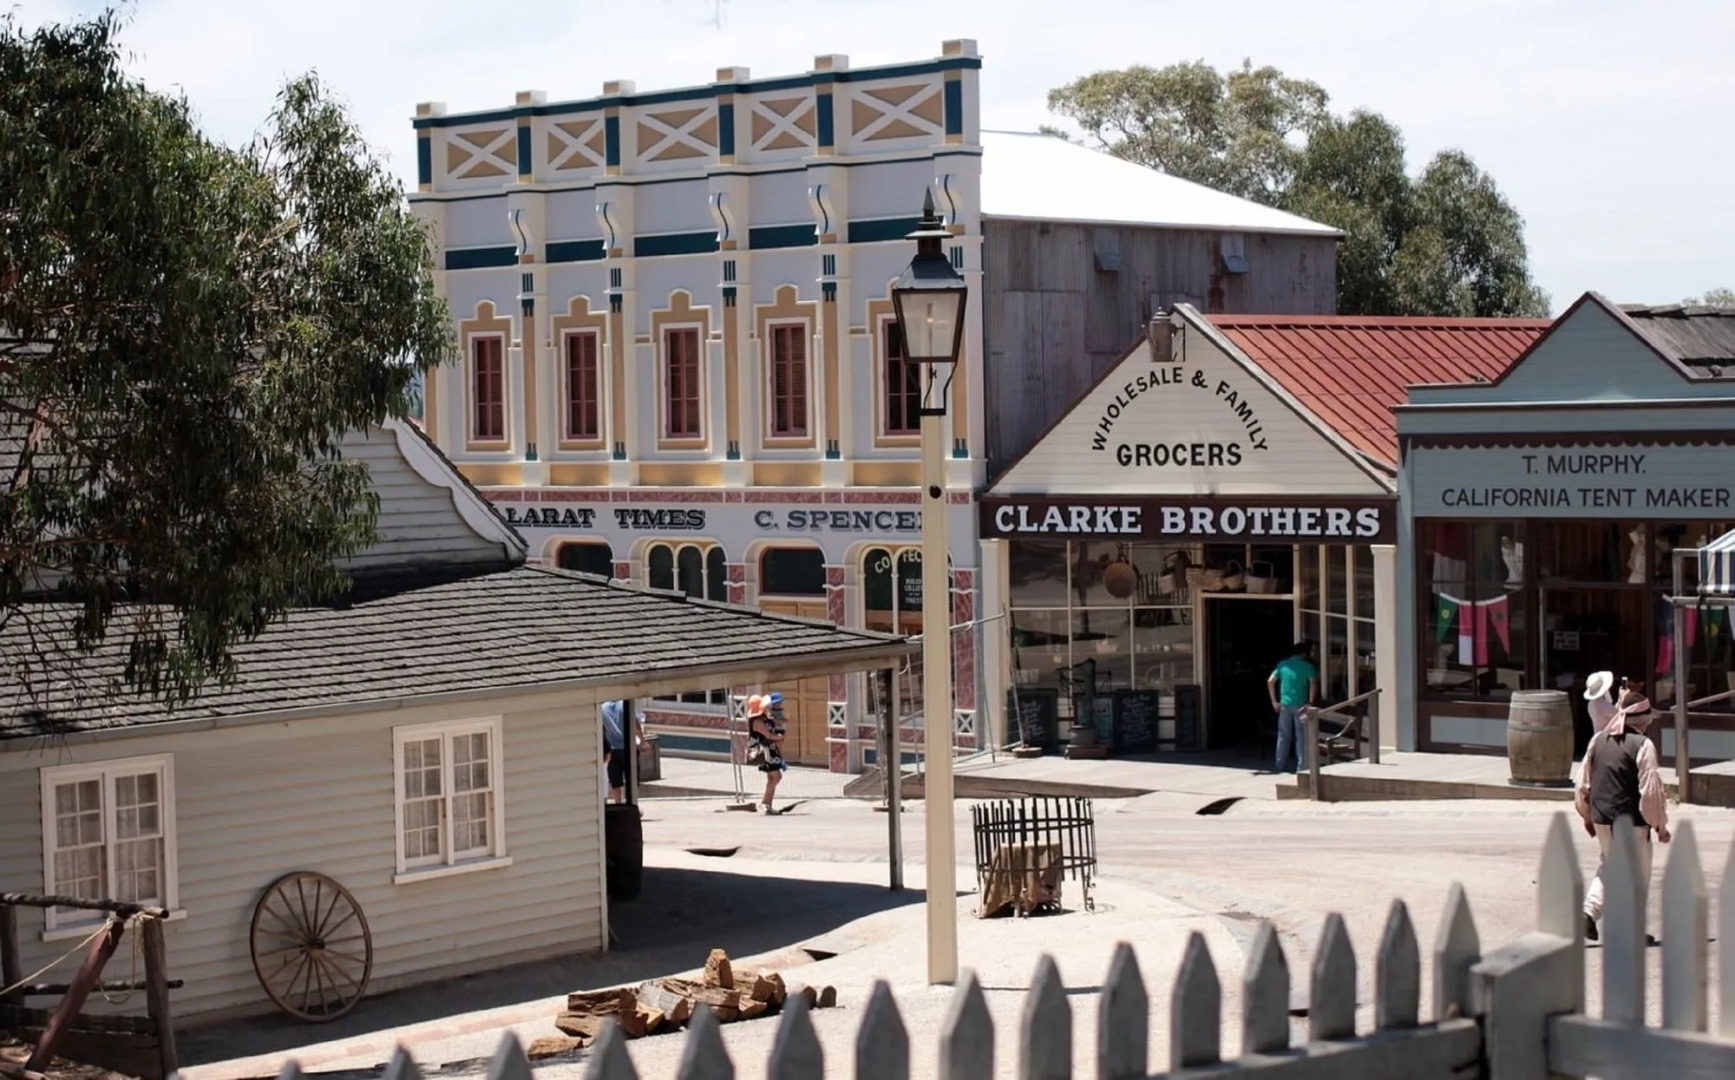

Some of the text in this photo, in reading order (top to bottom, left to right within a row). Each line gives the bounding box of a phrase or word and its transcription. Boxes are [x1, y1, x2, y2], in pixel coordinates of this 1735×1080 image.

[1092, 366, 1268, 451] WHOLESALE & FAMILY
[1116, 443, 1242, 467] GROCERS
[1521, 454, 1646, 474] T. MURPHY.
[1441, 488, 1731, 508] CALIFORNIA TENT MAKER
[504, 507, 705, 530] LARAT TIMES
[754, 510, 922, 532] C. SPENCE
[995, 506, 1380, 537] CLARKE BROTHERS
